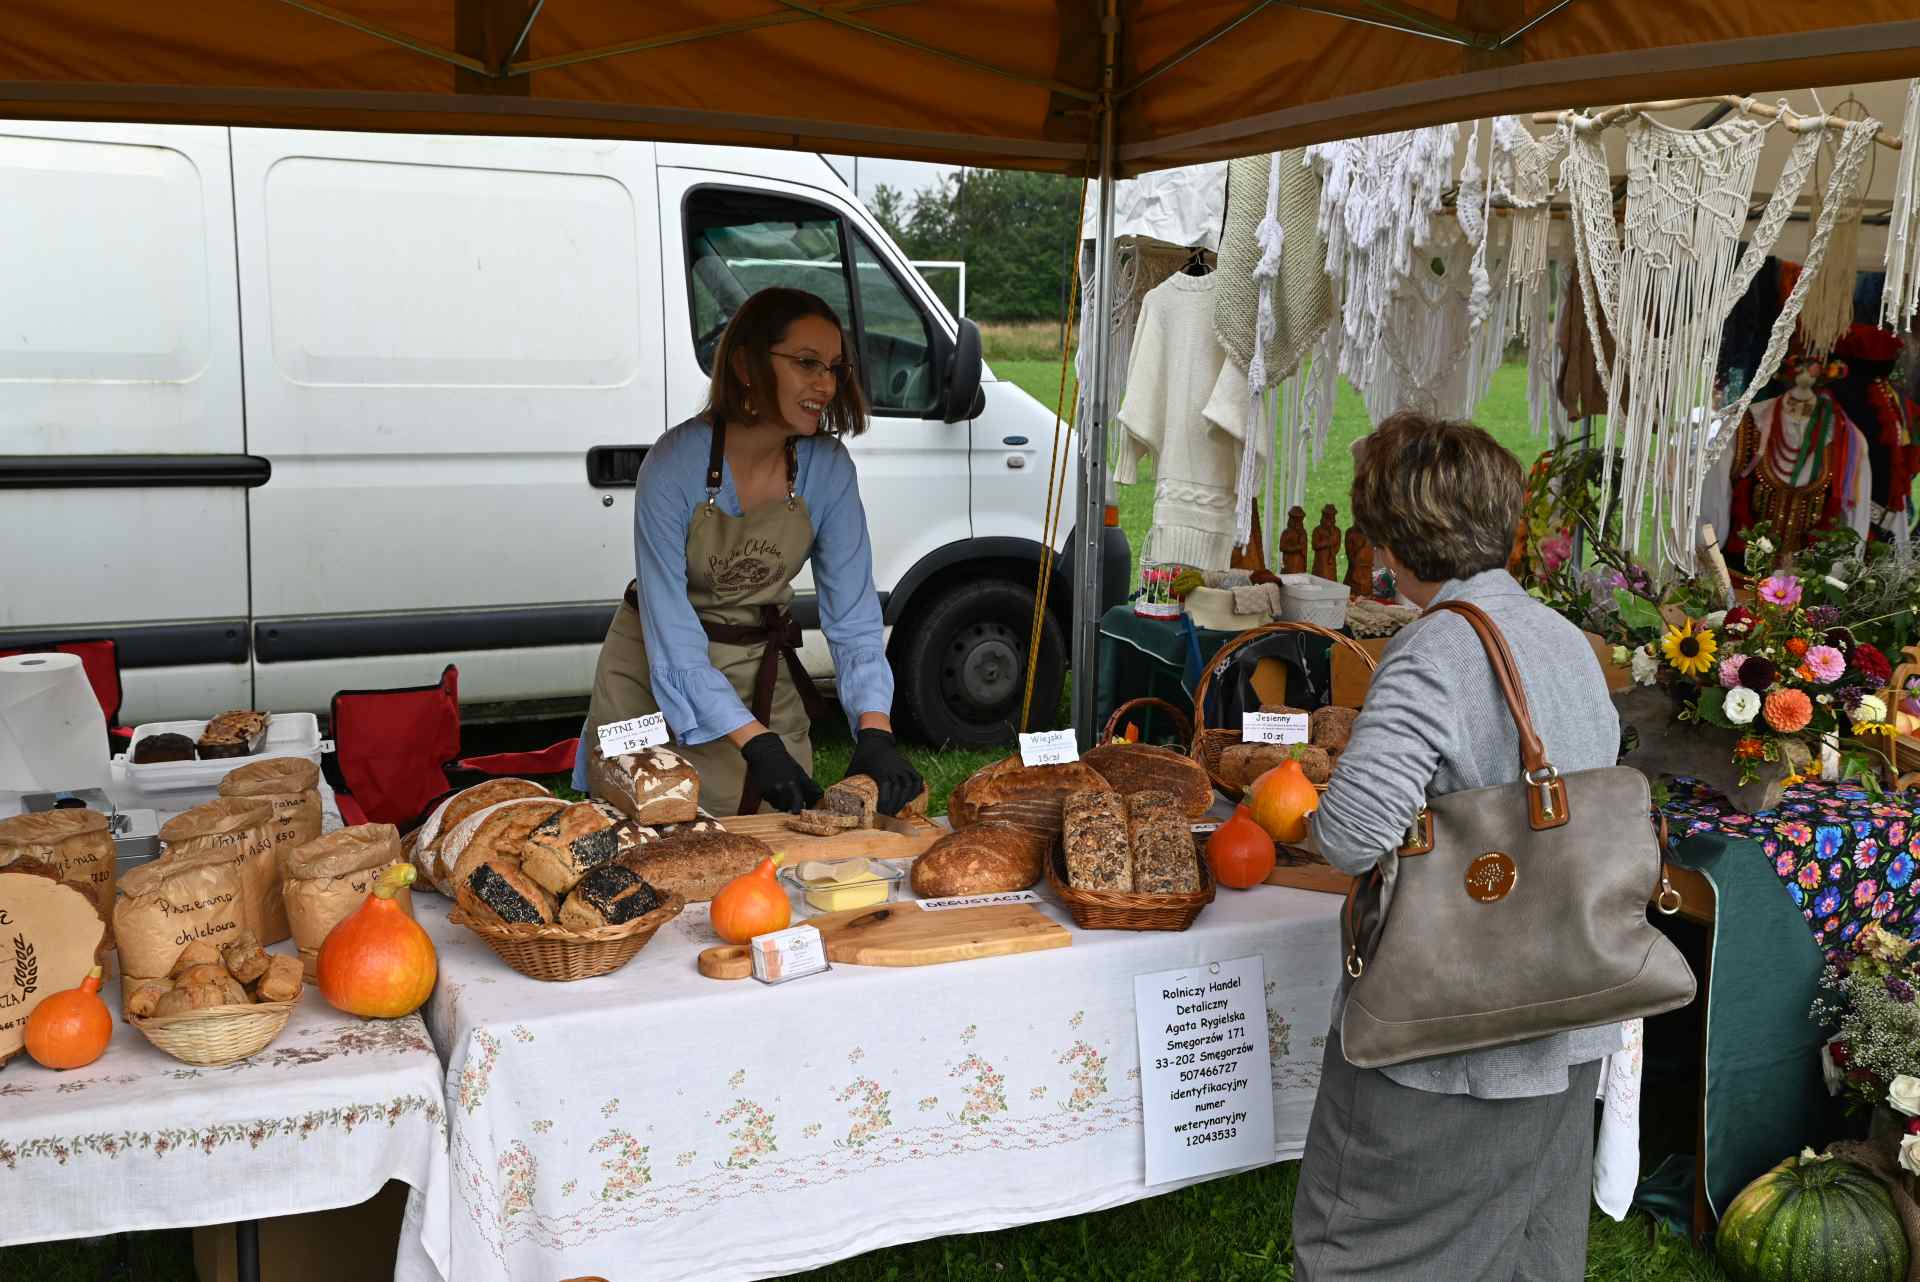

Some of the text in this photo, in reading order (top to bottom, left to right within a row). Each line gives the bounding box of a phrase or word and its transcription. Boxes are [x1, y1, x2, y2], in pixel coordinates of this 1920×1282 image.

[638, 714, 663, 728] 100%
[1255, 714, 1291, 724] Jesienny
[624, 740, 636, 750] 15
[1263, 732, 1273, 740] 10
[925, 894, 1035, 908] DEGUSTACJA
[1162, 976, 1241, 1000] Rolniczy Handel
[1176, 999, 1228, 1016] Detaliczny
[1165, 1010, 1245, 1036] Agata Rygielska
[1167, 1026, 1245, 1051] Smęgorzów 171
[1155, 1042, 1254, 1069] 33-202 Smęgorzów
[1180, 1061, 1238, 1082] 507466727
[1170, 1078, 1249, 1101] identyfikacyjny
[1195, 1099, 1226, 1113] numer
[1174, 1111, 1247, 1133] weterynaryjny
[1186, 1127, 1237, 1147] 12043533
